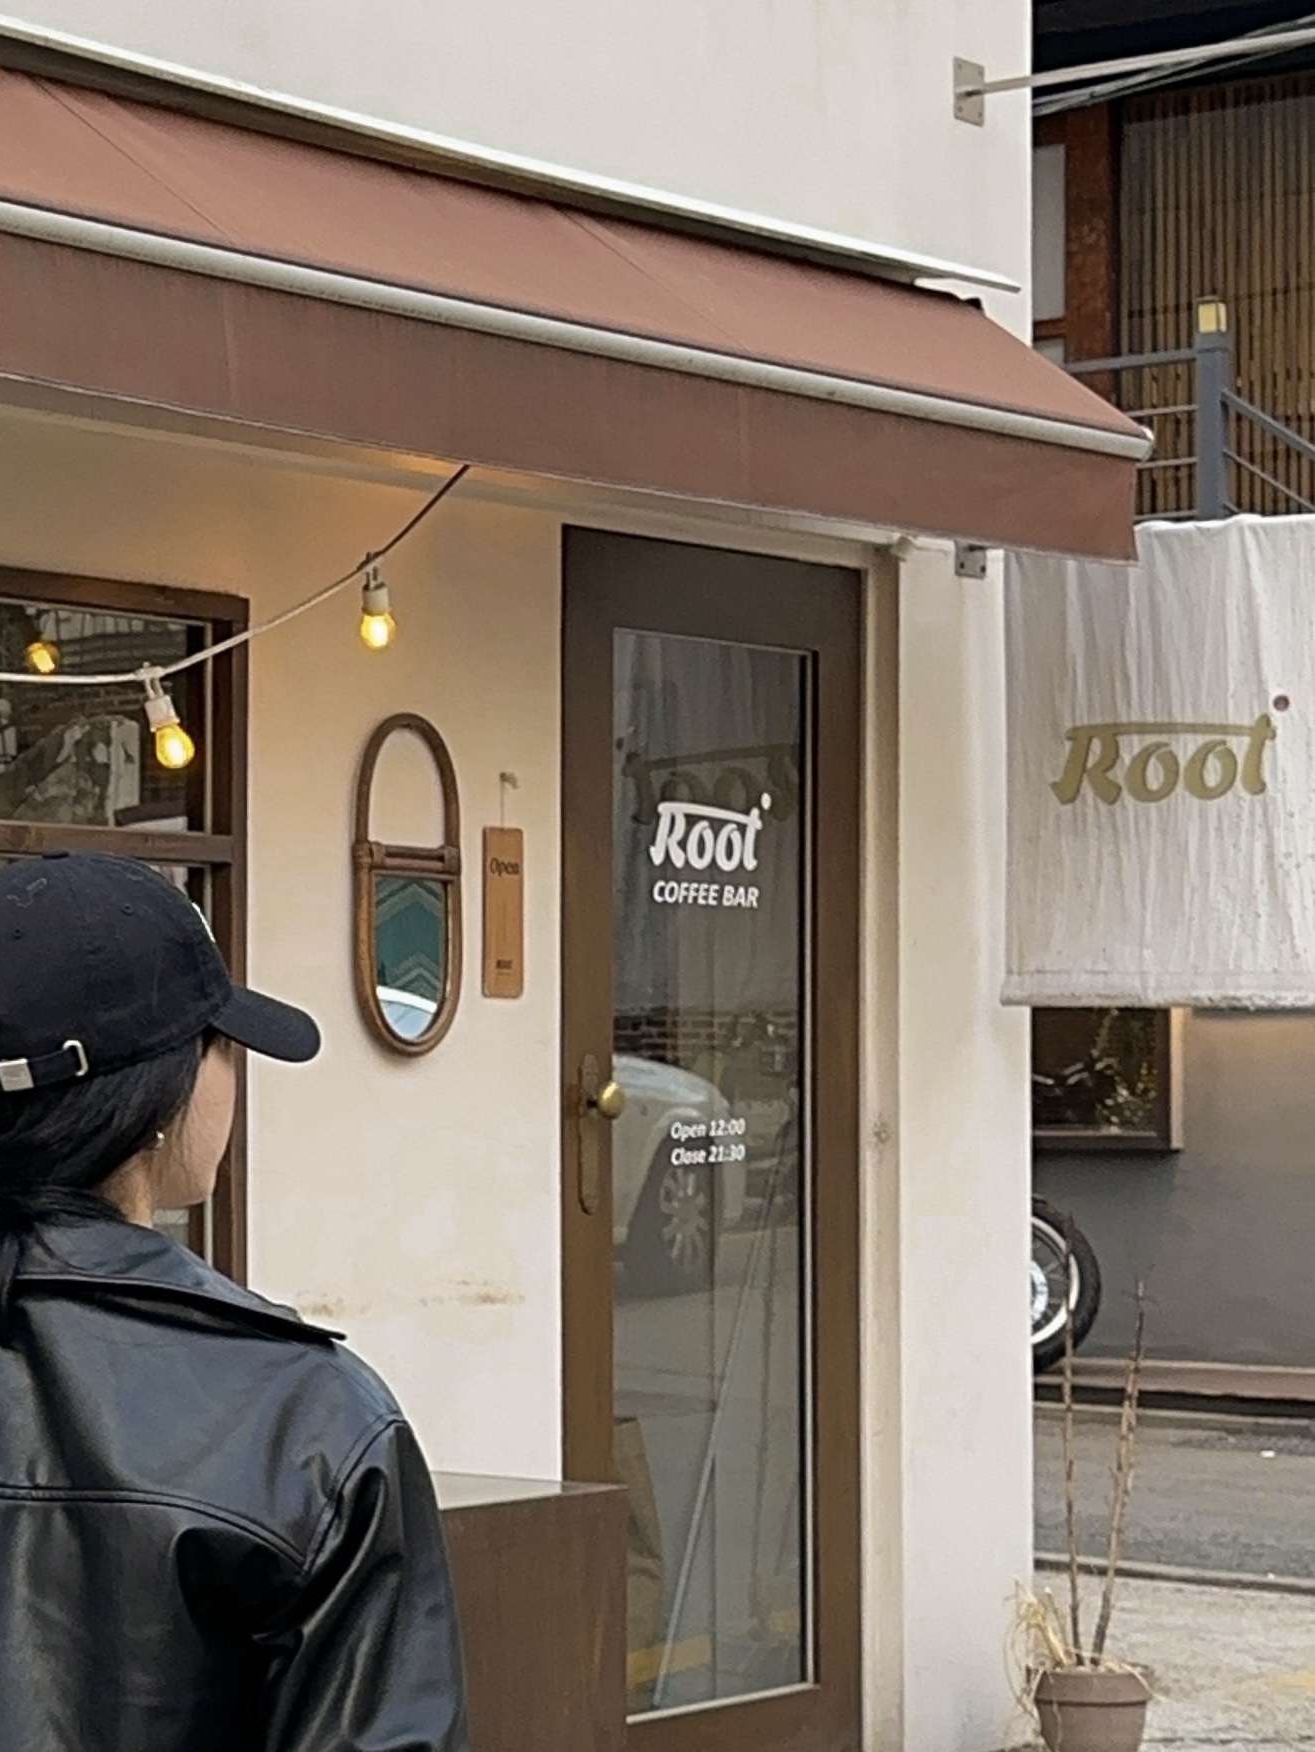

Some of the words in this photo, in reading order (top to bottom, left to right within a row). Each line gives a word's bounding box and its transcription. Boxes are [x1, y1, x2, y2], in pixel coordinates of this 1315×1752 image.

[1050, 713, 1276, 805] Root
[649, 800, 764, 871] Root
[489, 857, 520, 877] Open
[652, 880, 720, 906] COFFEE
[722, 884, 759, 909] BAR
[670, 1121, 706, 1141] Open
[708, 1118, 746, 1136] 12:00
[670, 1147, 706, 1165] Close
[708, 1144, 746, 1163] 21:30
